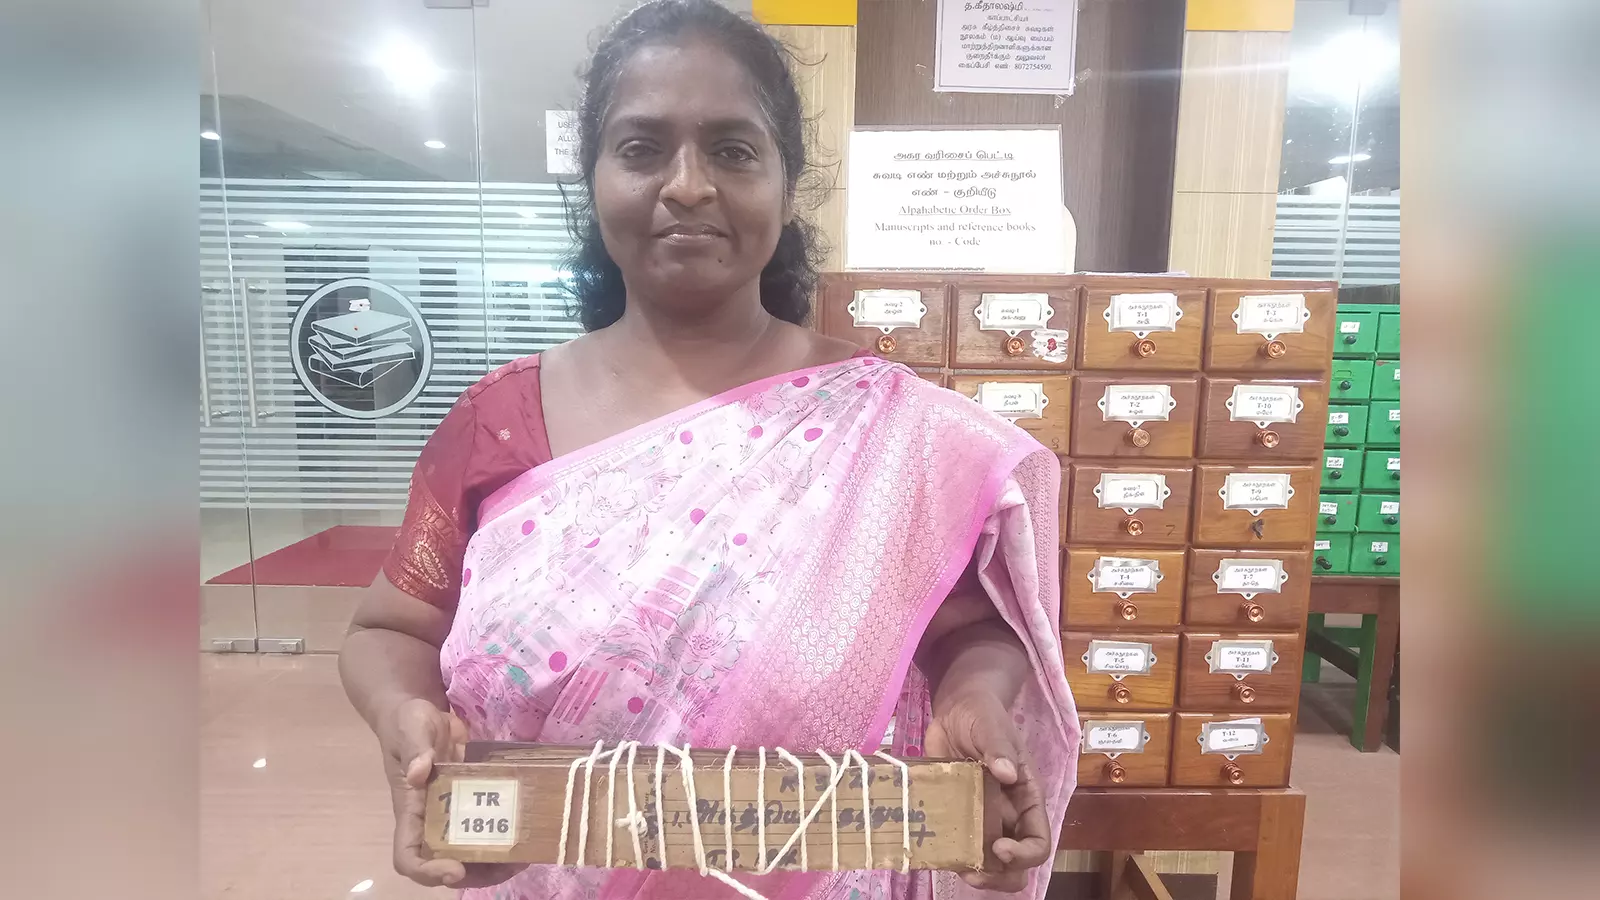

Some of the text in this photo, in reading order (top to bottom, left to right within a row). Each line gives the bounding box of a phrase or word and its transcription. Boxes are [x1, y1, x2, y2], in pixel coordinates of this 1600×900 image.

[894, 150, 1013, 161] அகர வரிசைப் பெட்டி
[873, 169, 1036, 181] சுவடி எண் மற்றும் அச்சுநூல்
[912, 187, 938, 196] எண்
[953, 186, 996, 199] குறியீடு
[960, 205, 988, 214] Order
[992, 205, 1011, 214] Box
[875, 222, 1036, 234] Manuscripts and reference books
[955, 236, 980, 245] Code
[473, 792, 500, 806] TR
[461, 818, 509, 833] 1816
